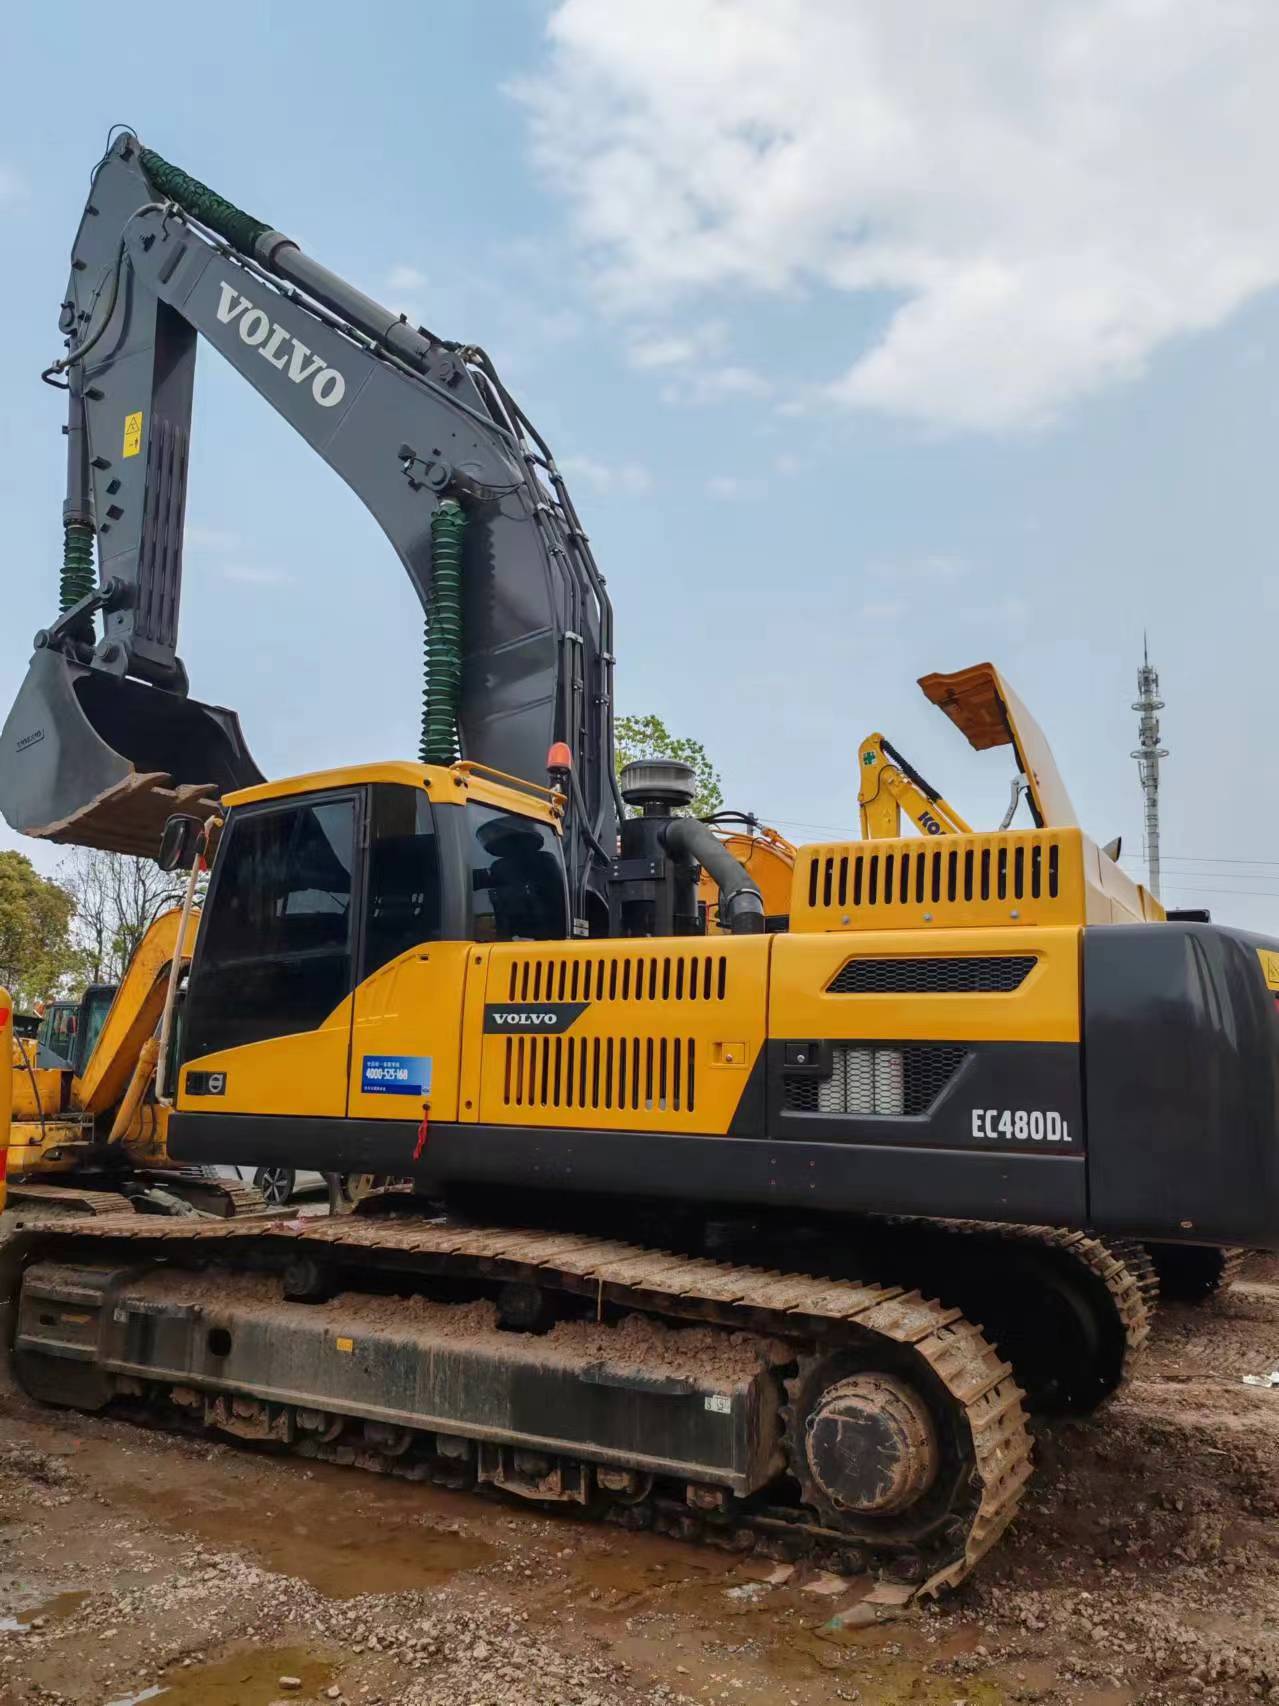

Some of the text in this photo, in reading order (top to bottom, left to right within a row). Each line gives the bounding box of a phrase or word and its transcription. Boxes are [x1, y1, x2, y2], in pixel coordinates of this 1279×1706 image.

[216, 280, 346, 407] VOLVO
[918, 811, 947, 835] KO
[492, 1013, 557, 1025] VOLVO
